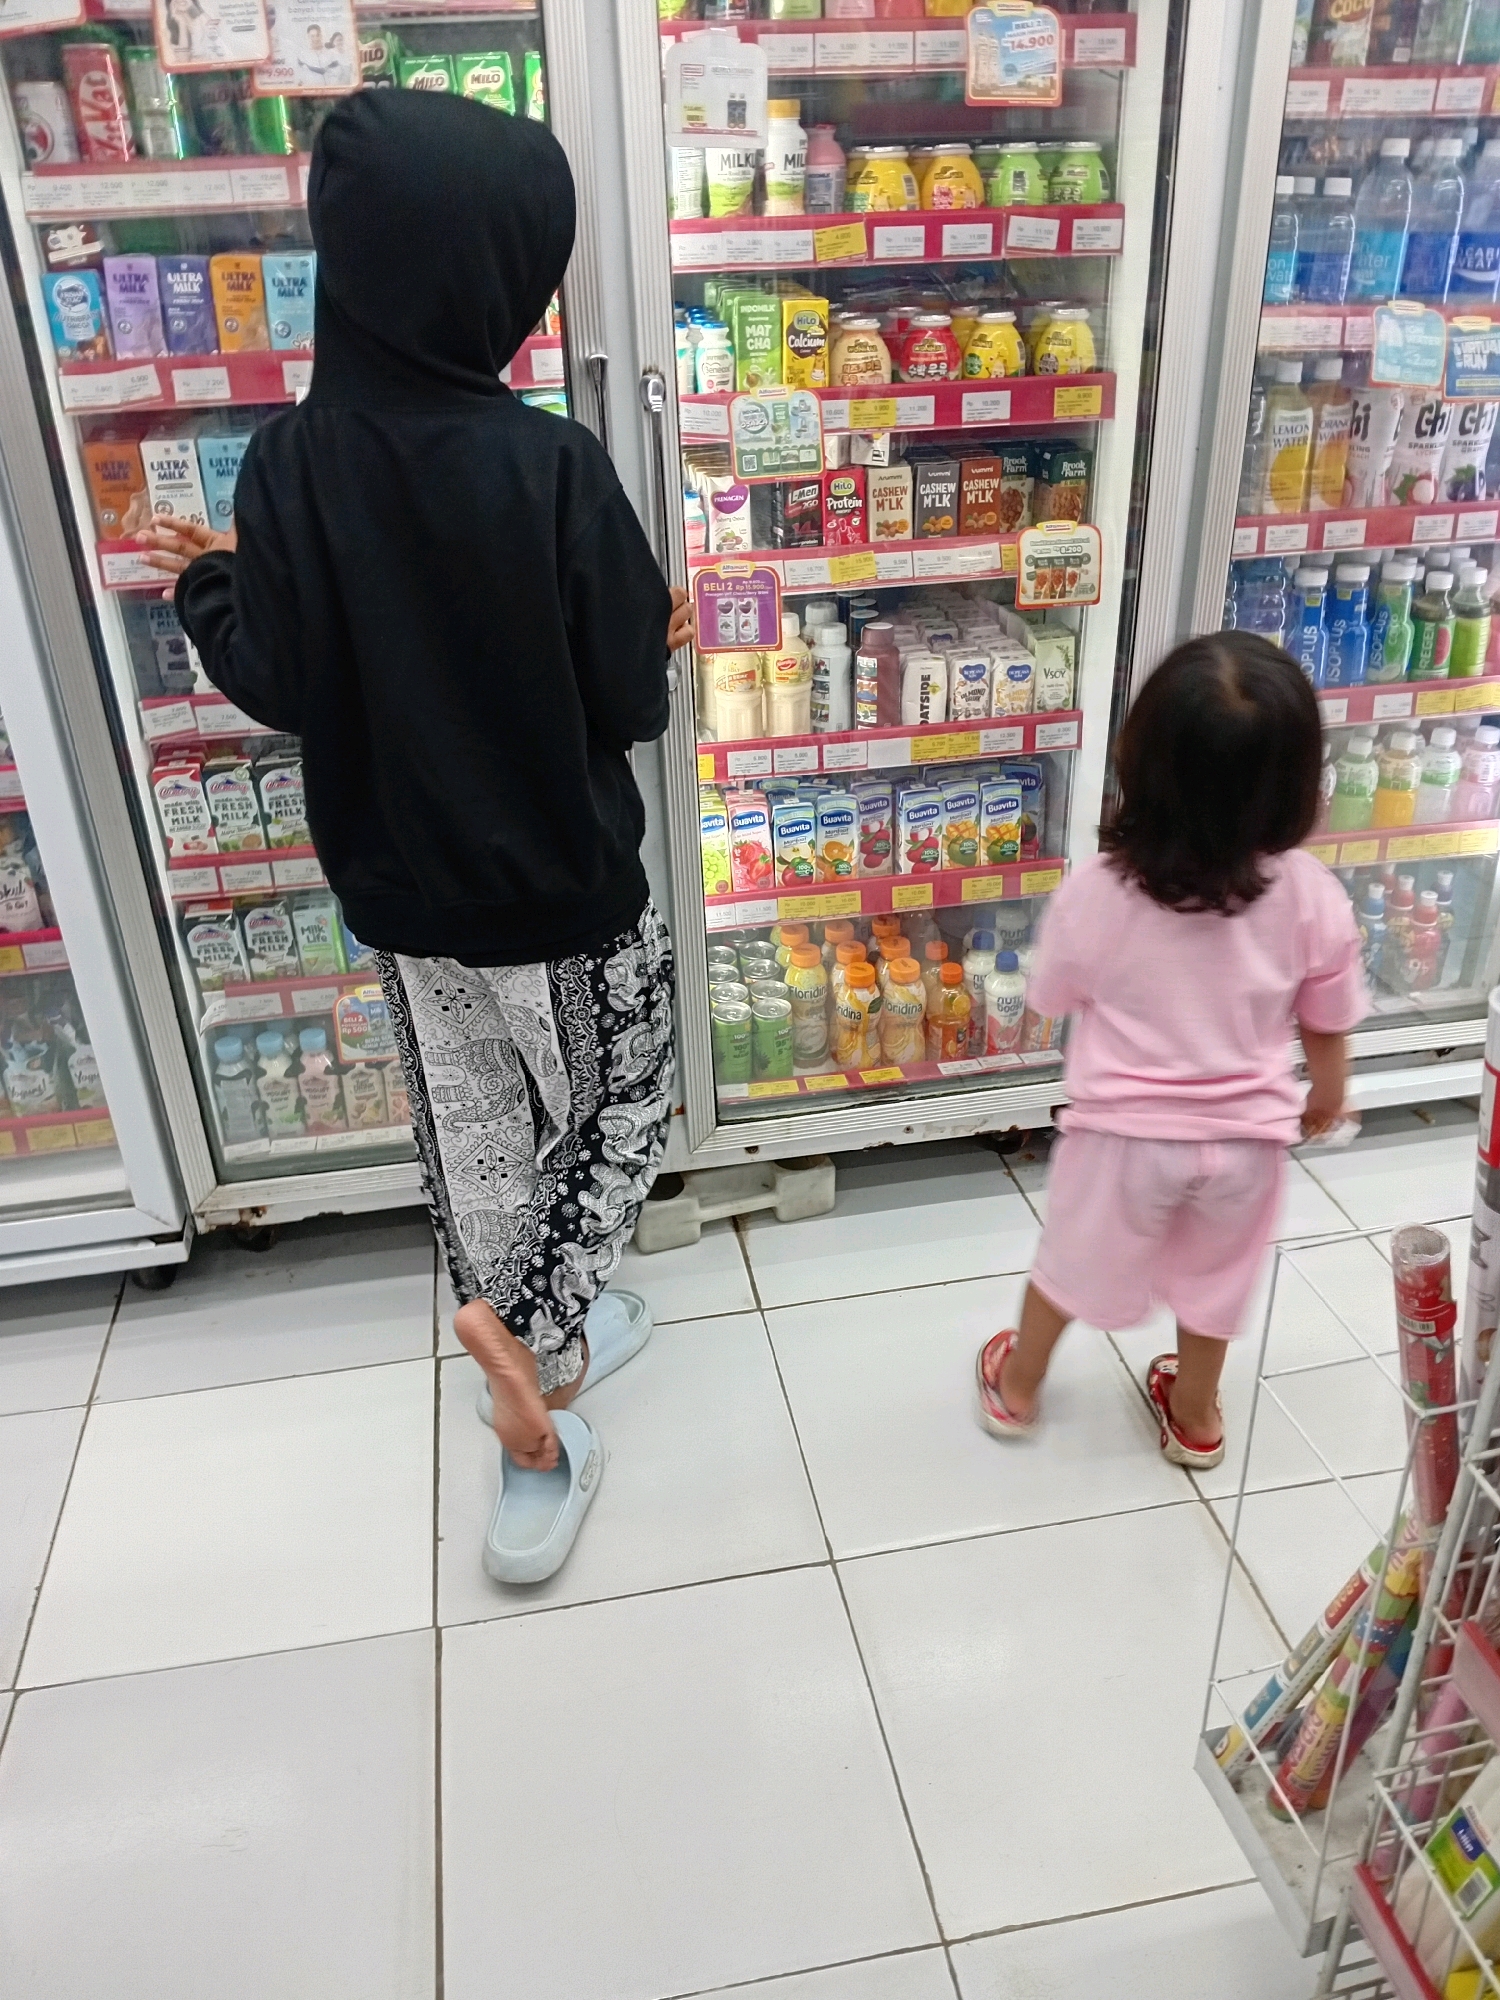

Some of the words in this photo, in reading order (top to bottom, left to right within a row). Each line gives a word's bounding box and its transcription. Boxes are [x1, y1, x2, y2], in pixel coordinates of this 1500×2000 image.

[1010, 34, 1055, 51] 14.900
[360, 48, 384, 63] ILO
[413, 76, 445, 91] MILO
[470, 72, 501, 84] MILO
[113, 273, 150, 284] ULTRA
[167, 272, 204, 284] ULTRA
[222, 271, 256, 282] ULTRA
[272, 277, 308, 288] ULTRA
[119, 282, 147, 294] MILK
[173, 282, 201, 294] MILK
[226, 281, 253, 292] MILK
[277, 287, 305, 298] MILK
[740, 304, 776, 313] INDOMILK
[796, 315, 817, 326] HiLo
[745, 324, 772, 337] MAT
[746, 338, 772, 351] CHA
[788, 334, 826, 348] Calcium
[1463, 353, 1488, 371] RUN
[908, 363, 927, 377] 수박
[928, 362, 948, 376] 우유
[1349, 399, 1371, 442] hi
[1272, 424, 1310, 436] LEMON
[1273, 435, 1309, 449] WATER
[150, 459, 189, 471] ULTRA
[1003, 455, 1027, 465] Brook
[1062, 460, 1086, 471] Brook
[96, 461, 130, 473] ULTRA
[1003, 463, 1028, 474] Farm
[1061, 468, 1087, 478] Farm
[102, 471, 130, 481] MILK
[157, 469, 187, 481] MILK
[833, 482, 853, 490] HiLo
[920, 482, 957, 495] CASHEW
[963, 478, 1000, 491] CASHEW
[788, 485, 818, 505] L-Men
[872, 485, 909, 499] CASHEW
[714, 494, 745, 503] PRENAGEN
[803, 499, 819, 509] 2GO
[826, 496, 863, 511] Protein
[703, 583, 725, 592] BELI
[726, 582, 733, 590] 2
[1370, 611, 1389, 670] ISOPLUS
[1419, 622, 1436, 669] REGEN
[1326, 618, 1347, 683] ISOPLUS
[960, 688, 987, 701] ALMOND
[214, 801, 253, 812] FRESH
[859, 799, 889, 812] Buavita
[946, 797, 975, 810] Buavita
[988, 800, 1017, 813] Buavita
[164, 806, 203, 818] FRESH
[221, 811, 250, 822] MILK
[275, 808, 303, 819] MILK
[909, 808, 938, 821] Buavita
[171, 815, 201, 826] MILK
[701, 817, 724, 830] avita
[732, 814, 764, 828] Buavita
[823, 813, 852, 825] Buavita
[780, 823, 810, 836] Buavita
[301, 924, 325, 937] Milk
[252, 936, 289, 947] FRESH
[306, 933, 328, 944] Life
[196, 946, 235, 956] FRESH
[258, 944, 286, 953] MILK
[203, 954, 232, 963] MILK
[997, 995, 1024, 1004] nutri
[997, 1002, 1023, 1014] boost
